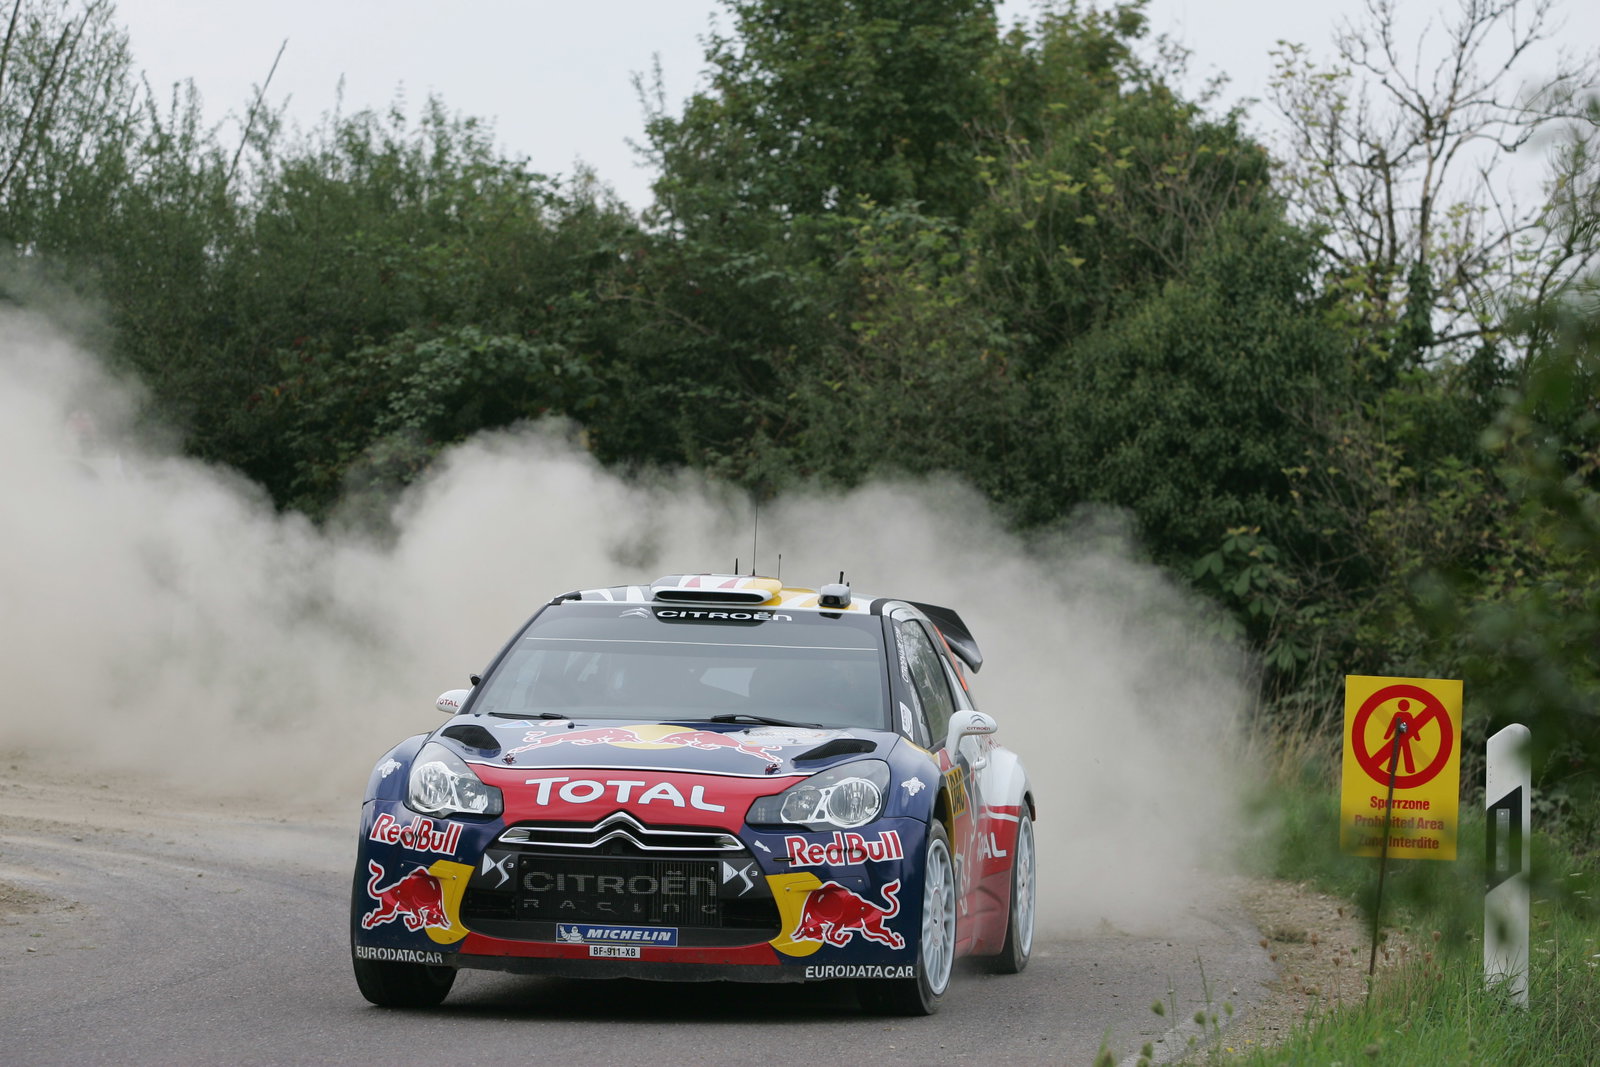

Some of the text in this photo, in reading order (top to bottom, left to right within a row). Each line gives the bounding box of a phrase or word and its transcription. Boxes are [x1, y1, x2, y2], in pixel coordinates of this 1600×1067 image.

[525, 776, 726, 813] TOTAL
[1416, 817, 1445, 831] Area
[1388, 836, 1440, 850] Interdite
[586, 928, 671, 941] MICHELIN
[356, 945, 443, 964] EURODATACAR
[593, 946, 636, 958] BF-911-XB
[805, 964, 914, 979] EURODATACAR
